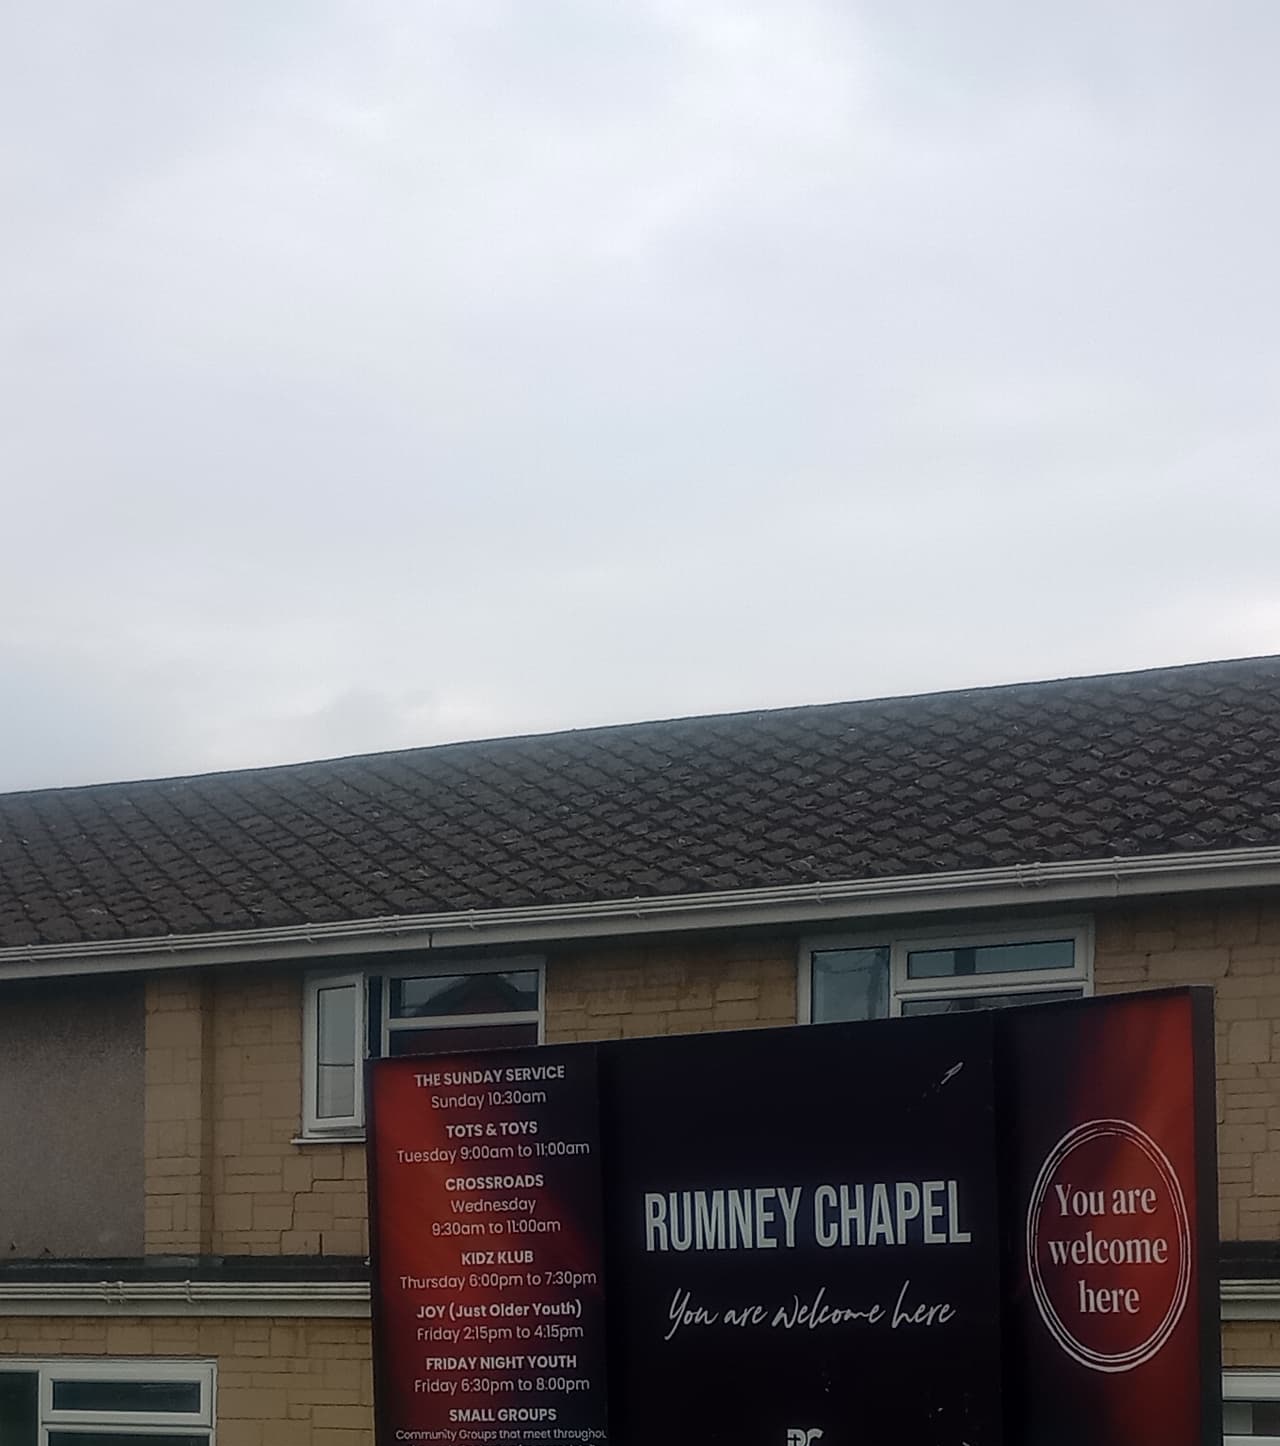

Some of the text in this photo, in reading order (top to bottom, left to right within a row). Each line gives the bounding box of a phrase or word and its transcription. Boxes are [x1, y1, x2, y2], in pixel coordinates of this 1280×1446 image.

[414, 1065, 565, 1087] THE SUNDAY SERVICE
[431, 1090, 547, 1110] Sunday 10:30am
[446, 1121, 538, 1139] TOTS & TOYS
[398, 1141, 590, 1165] Tuesday 9:00am to 11:00am
[445, 1174, 544, 1191] CROSSROADS
[451, 1196, 537, 1214] Wednesday
[1055, 1184, 1157, 1216] You are
[644, 1180, 971, 1251] RUMNEY CHAPEL
[432, 1219, 561, 1237] 9:30am to 11:00am
[461, 1250, 534, 1265] KIDZ KLUB
[1048, 1231, 1168, 1265] welcome
[400, 1271, 597, 1291] Thursday 6:00pm to 7:30pm
[1078, 1280, 1140, 1313] here
[417, 1298, 582, 1321] JOY (Just Older Youth)
[664, 1280, 956, 1341] You are welcome here
[417, 1324, 584, 1343] Friday 2:15pm to 4:15pm
[426, 1354, 577, 1371] FRIDAY NIGHT YOUTH
[414, 1379, 458, 1396] Friday
[461, 1378, 514, 1395] 6:30pm
[517, 1378, 532, 1391] to
[449, 1407, 557, 1422] SMALL GROUPS
[395, 1428, 458, 1442] Community
[459, 1428, 498, 1442] Groups
[499, 1428, 521, 1440] that
[523, 1429, 552, 1440] meet
